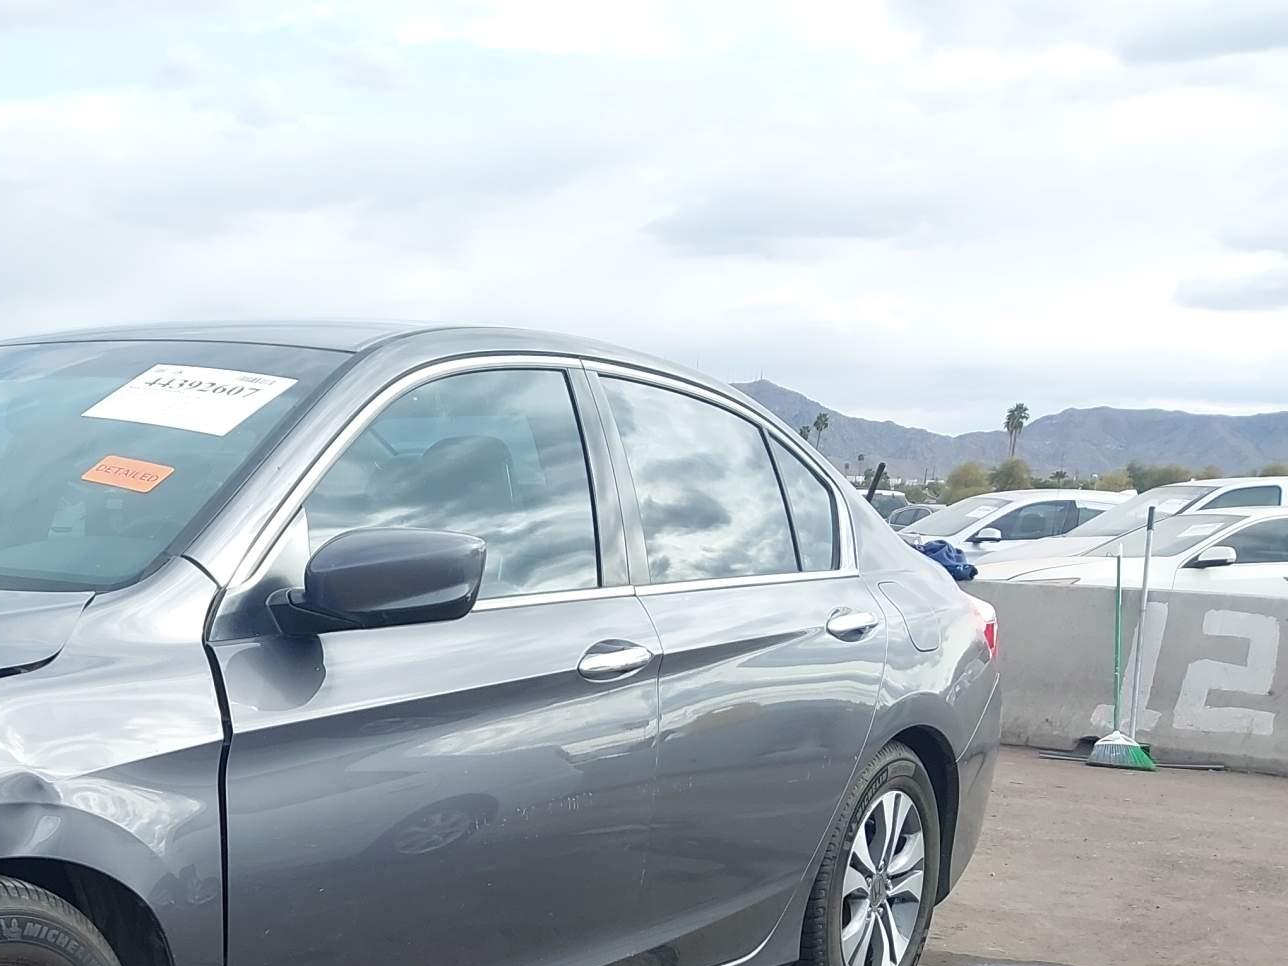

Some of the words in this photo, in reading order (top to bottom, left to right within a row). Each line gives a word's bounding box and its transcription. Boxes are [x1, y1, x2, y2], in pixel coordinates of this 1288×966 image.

[145, 377, 261, 398] 44392607
[95, 463, 160, 482] DETAILED
[1090, 601, 1281, 736] 12
